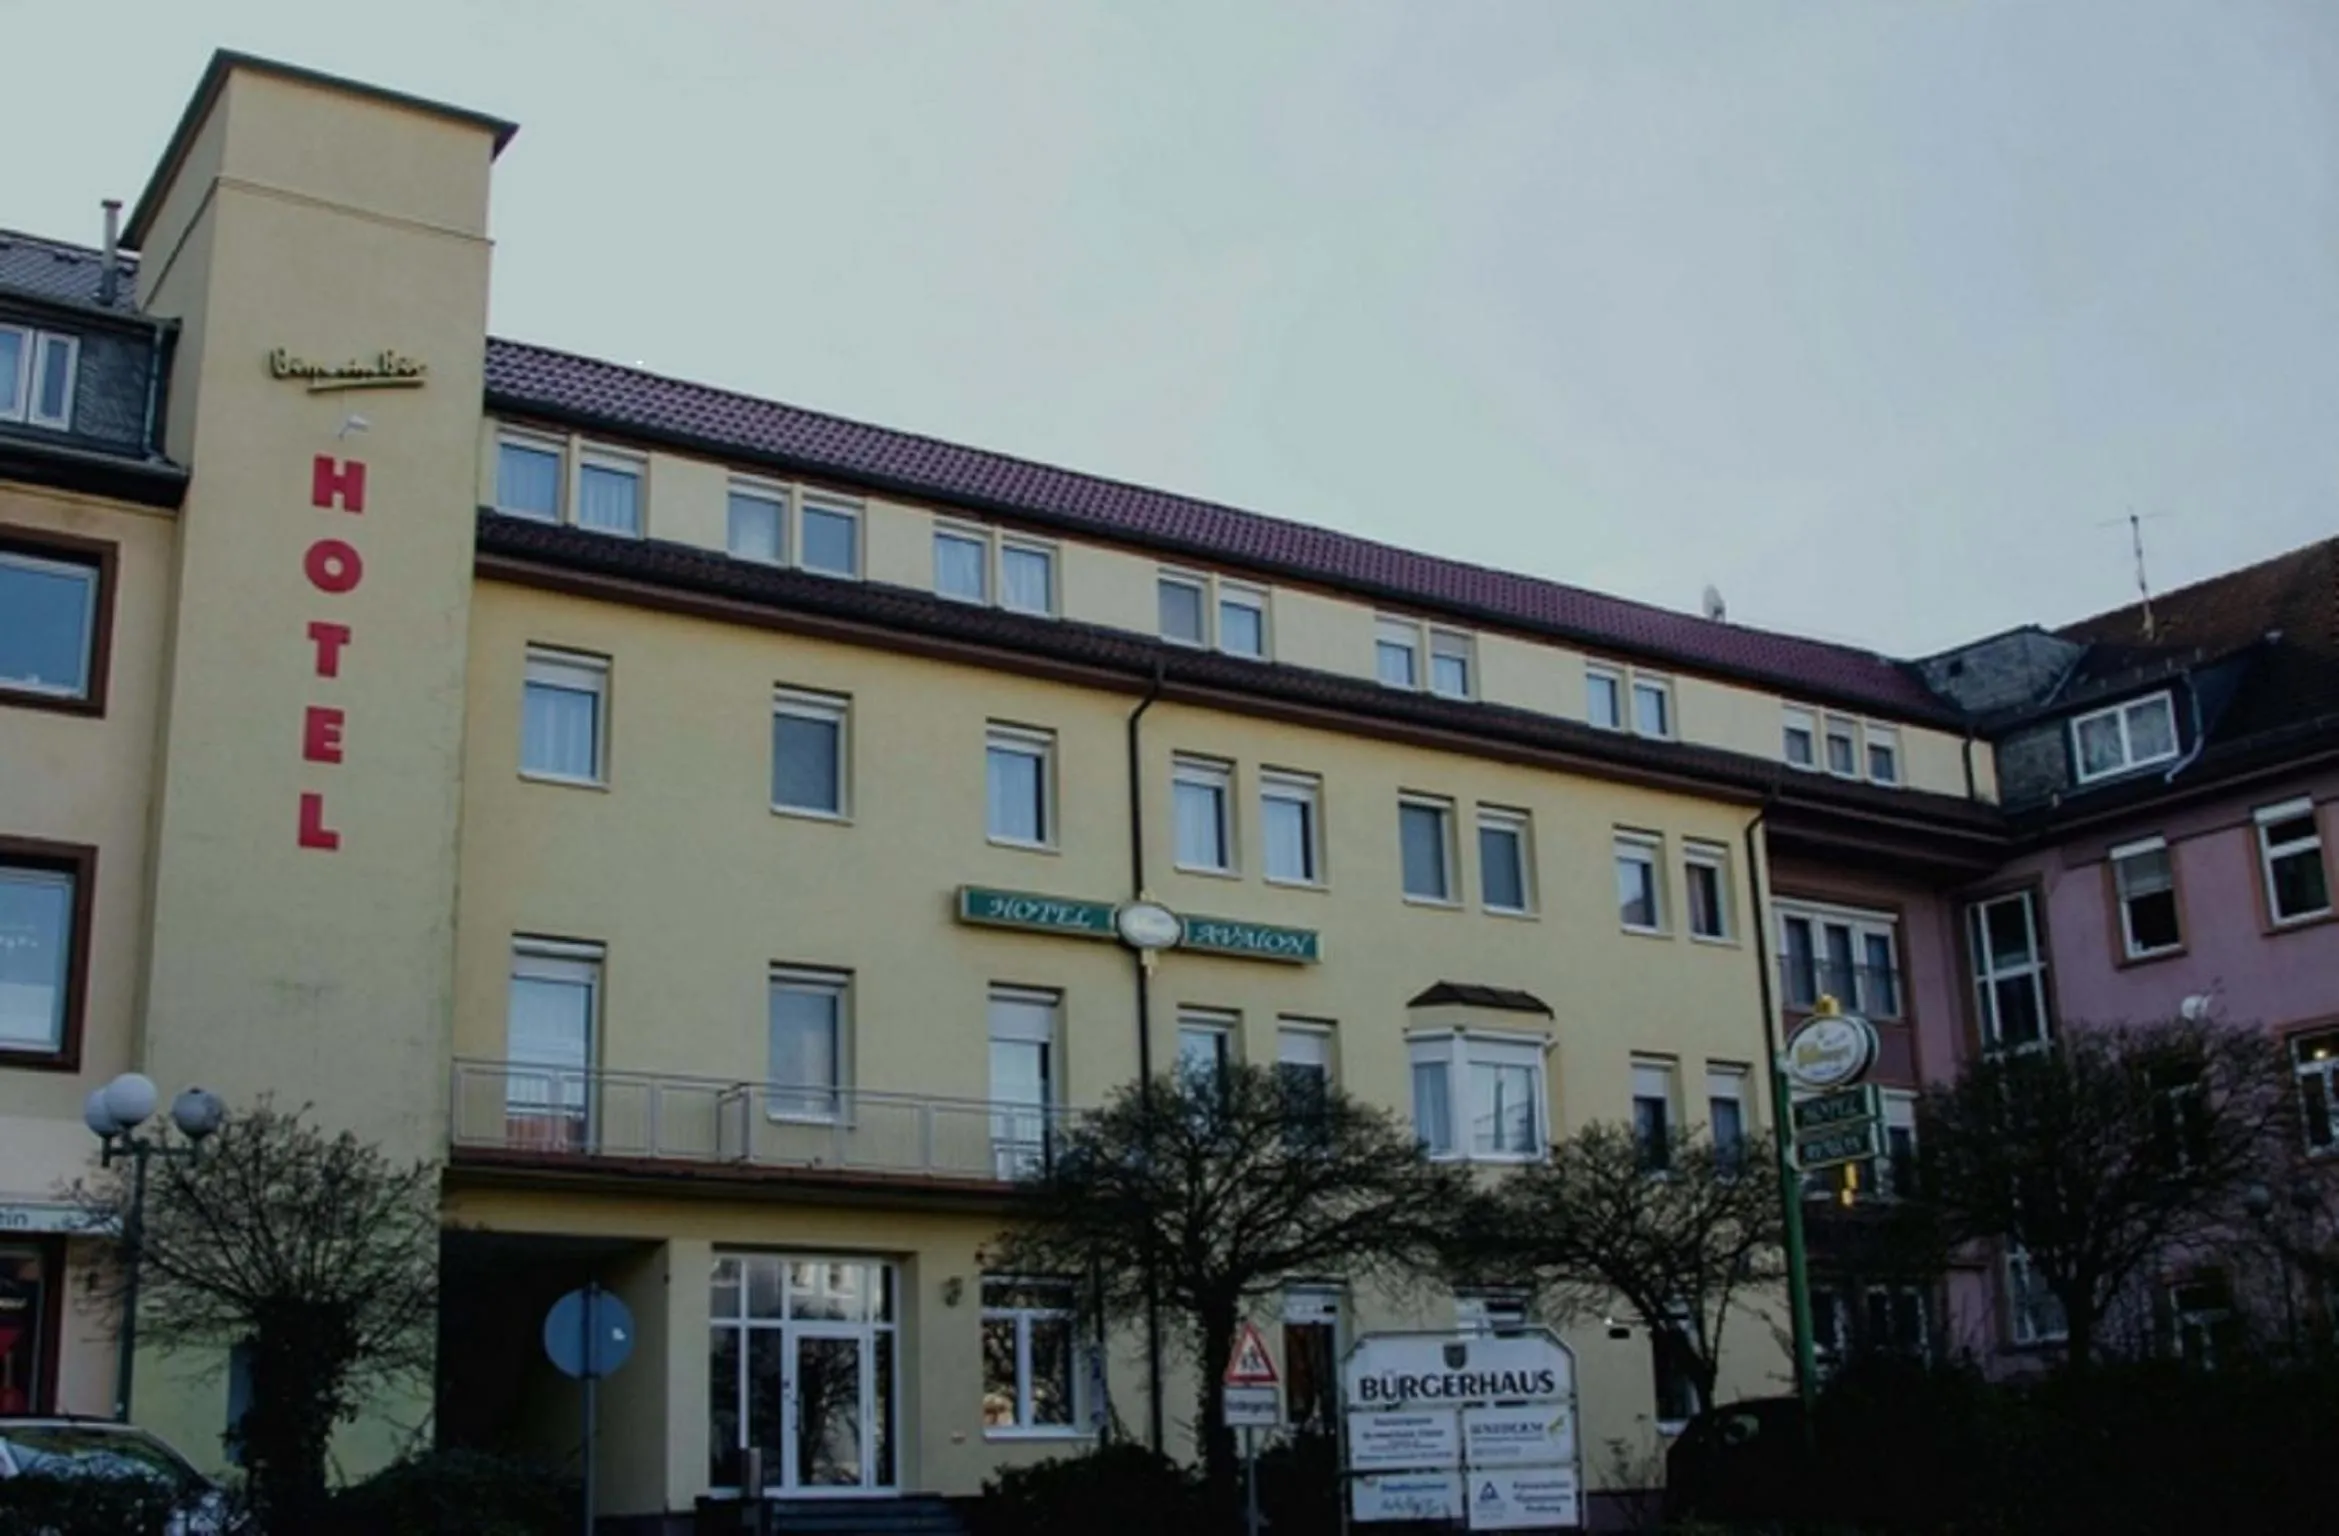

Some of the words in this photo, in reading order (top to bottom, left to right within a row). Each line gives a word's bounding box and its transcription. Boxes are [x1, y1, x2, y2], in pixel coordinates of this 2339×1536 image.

[297, 453, 366, 851] HOTEL
[988, 898, 1094, 929] HOTEL
[1359, 1369, 1555, 1400] BÜRGERHAUS
